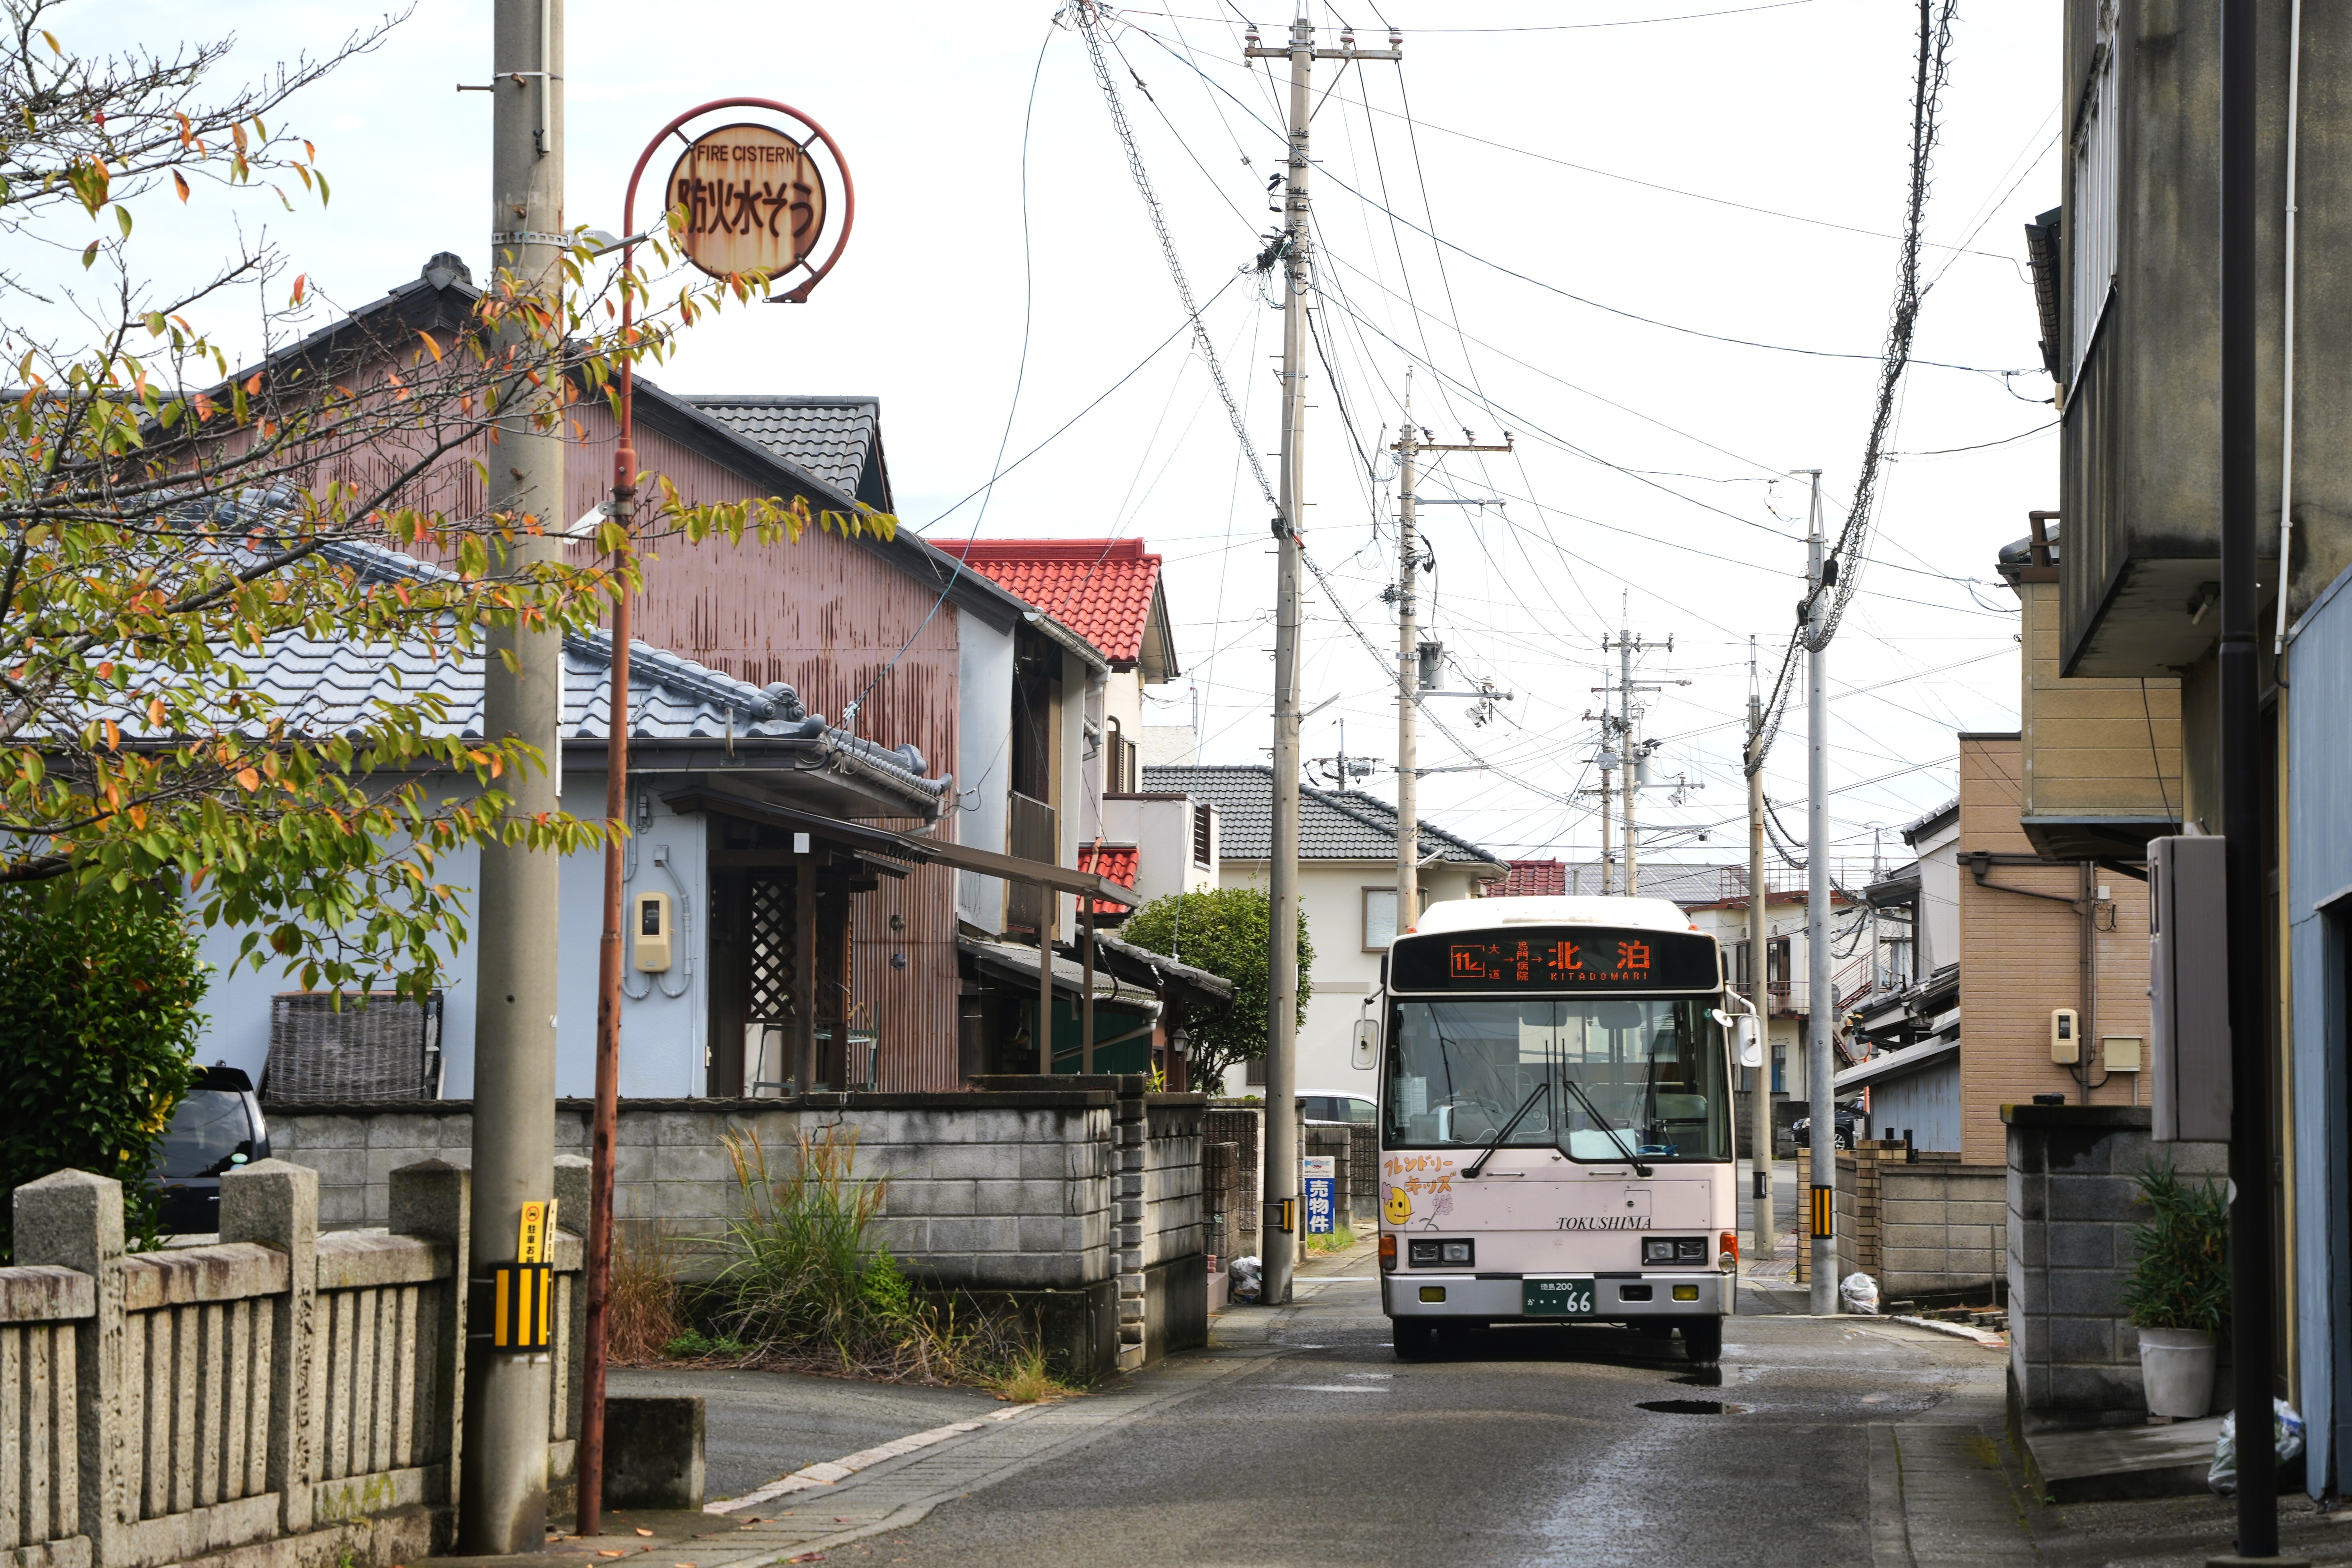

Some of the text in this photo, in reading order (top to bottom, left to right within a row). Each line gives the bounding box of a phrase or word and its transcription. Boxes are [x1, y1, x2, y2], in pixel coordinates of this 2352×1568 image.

[697, 145, 794, 163] FIRE CISTERN
[678, 179, 813, 238] 防火水そう
[1551, 972, 1647, 980] KITADOMARI
[1384, 1155, 1453, 1177] フレンドリー
[1405, 1171, 1456, 1195] キッズ
[1309, 1180, 1329, 1232] 売物件
[1558, 1217, 1651, 1229] TOKUSHIMA
